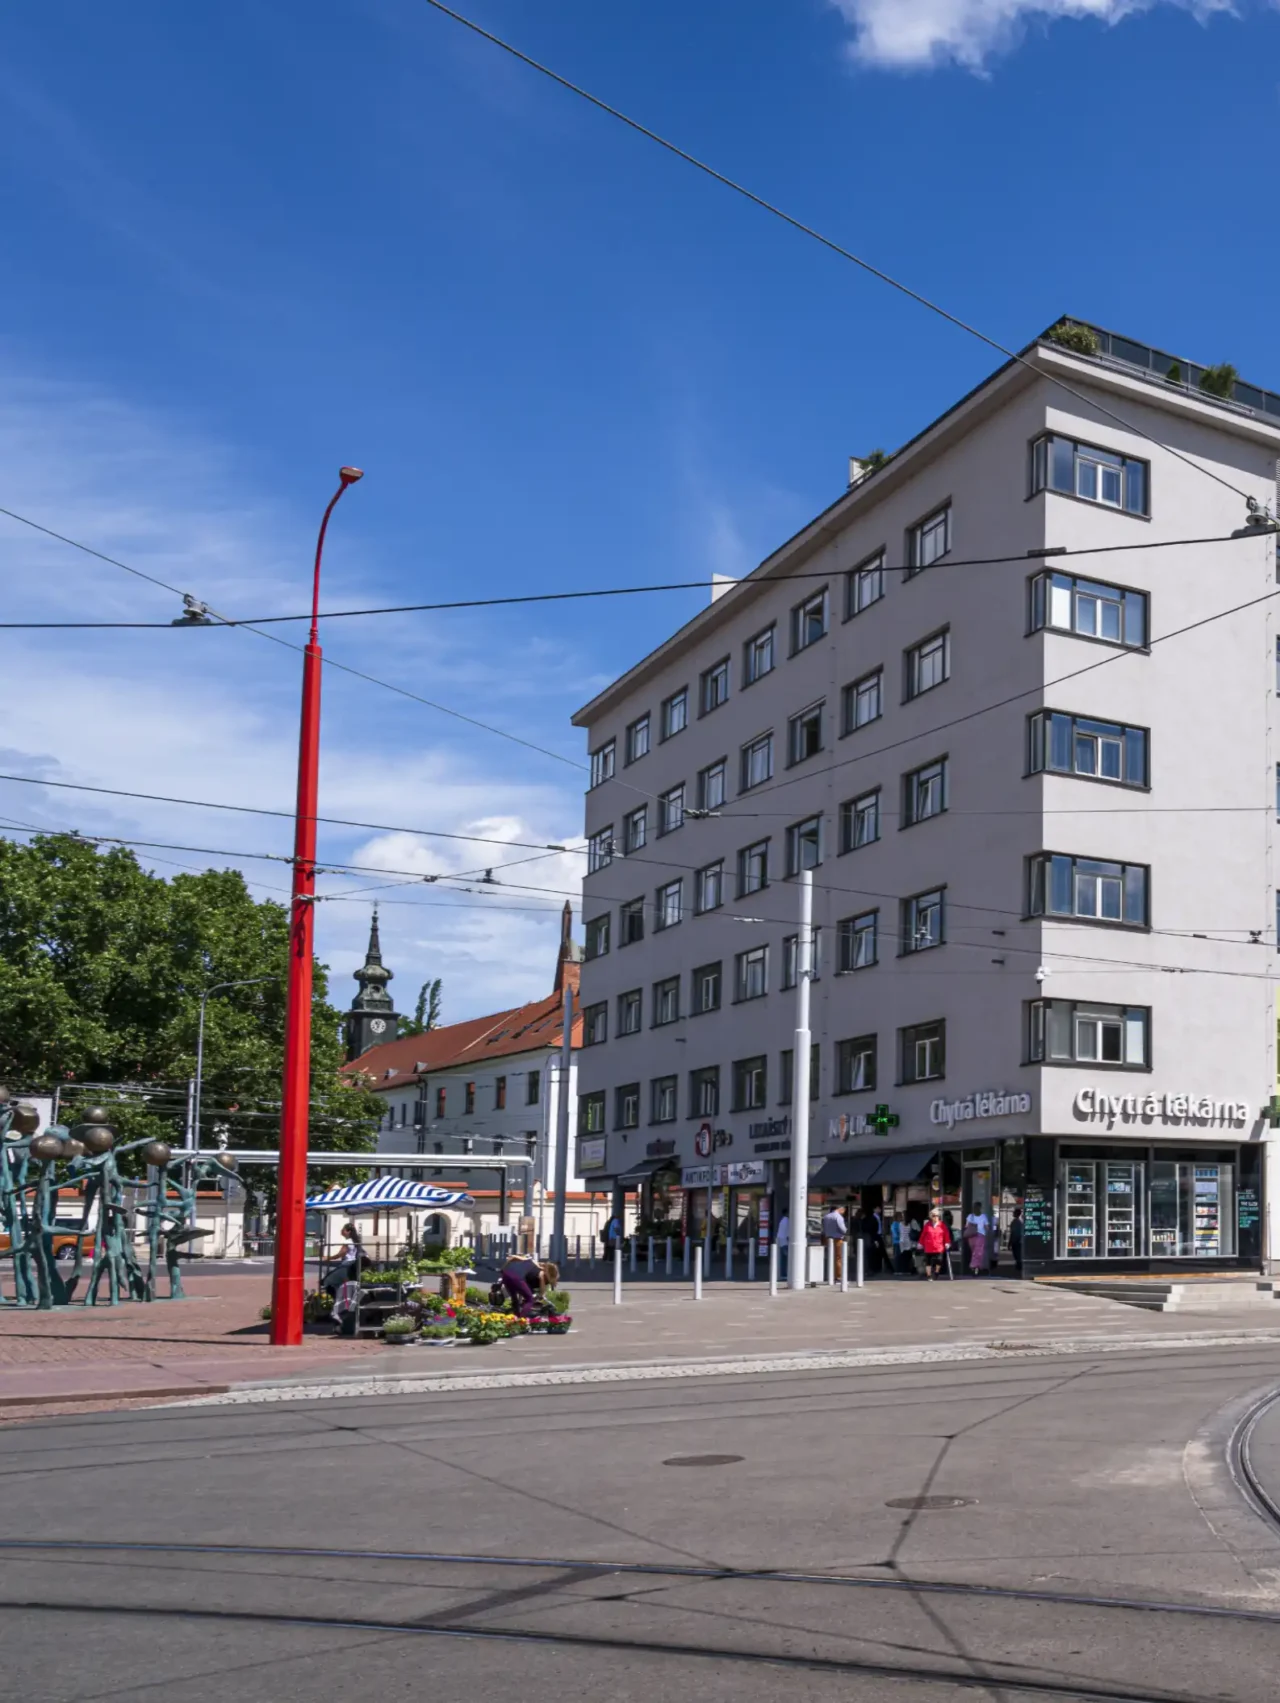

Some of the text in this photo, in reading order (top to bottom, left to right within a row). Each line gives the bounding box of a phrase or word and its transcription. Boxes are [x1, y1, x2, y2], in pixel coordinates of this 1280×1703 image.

[930, 1090, 1031, 1129] Chytrá lékárna
[1076, 1087, 1250, 1122] Chytrá lékárna
[684, 1170, 718, 1184] ANTIKFOO
